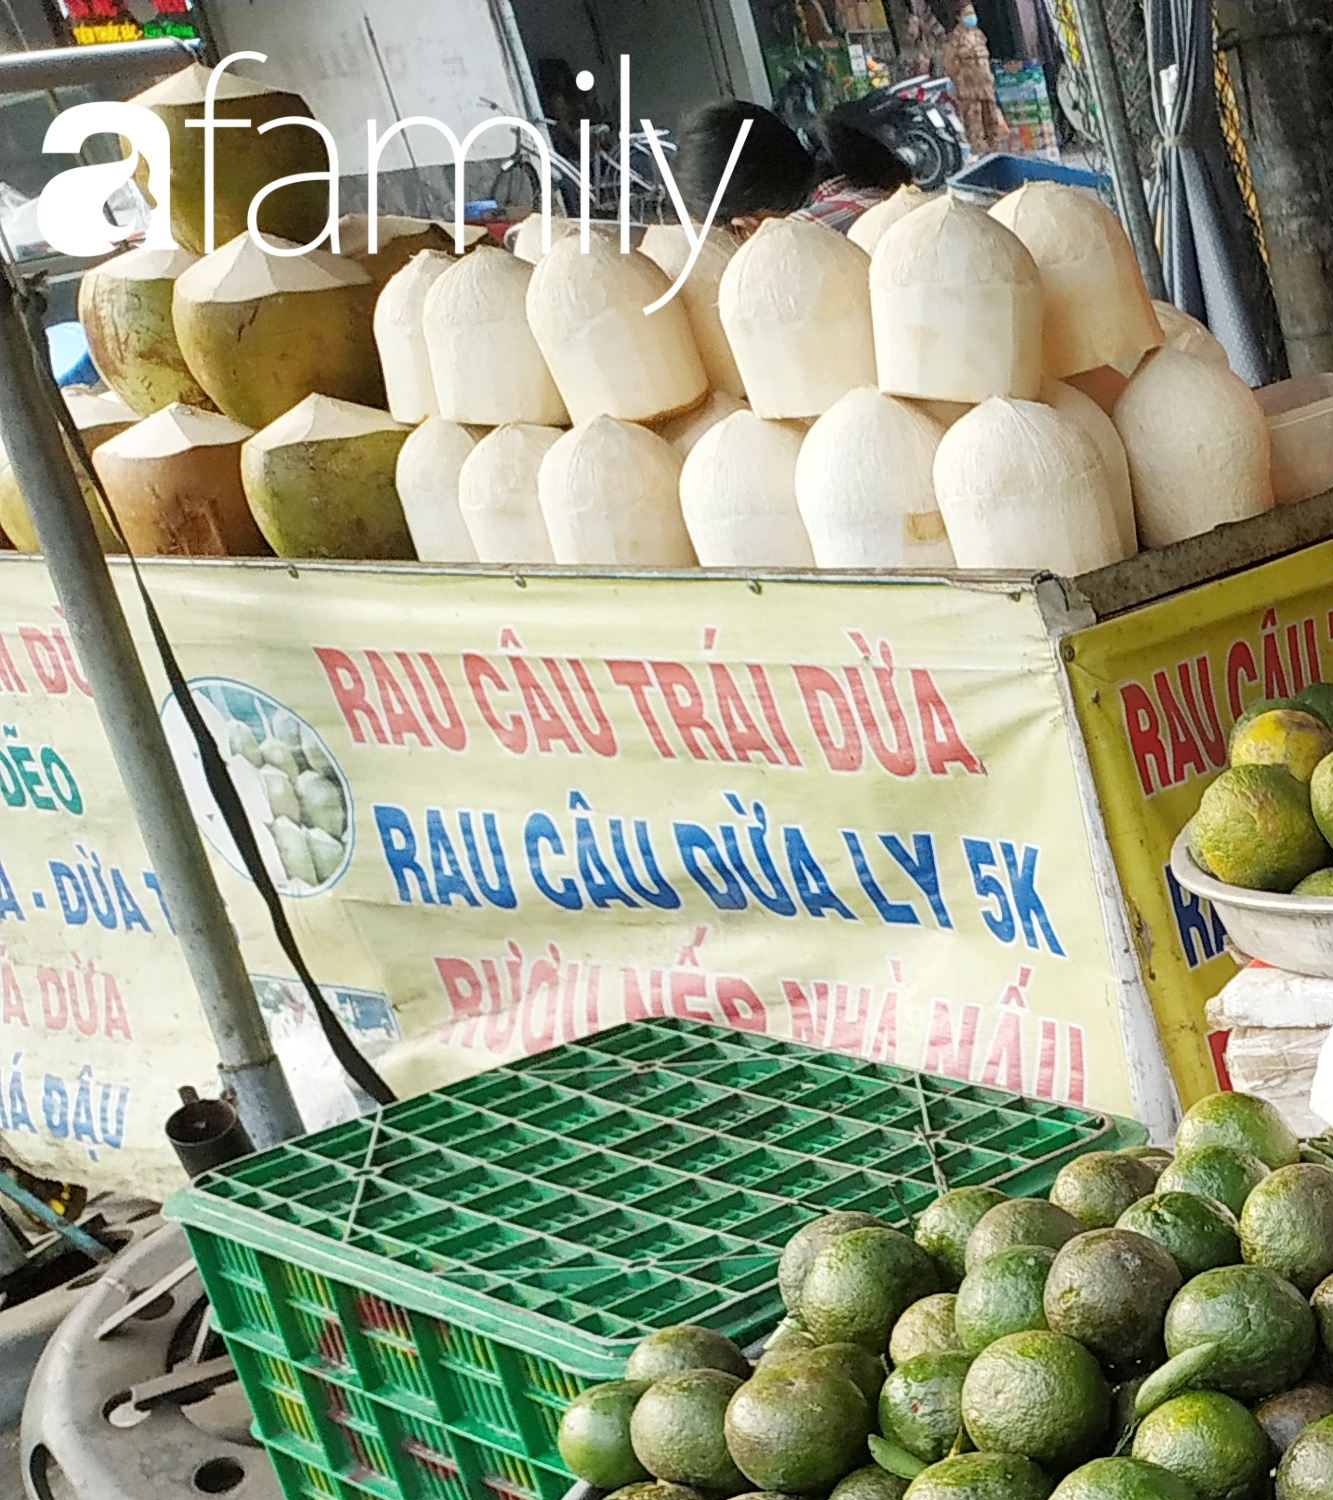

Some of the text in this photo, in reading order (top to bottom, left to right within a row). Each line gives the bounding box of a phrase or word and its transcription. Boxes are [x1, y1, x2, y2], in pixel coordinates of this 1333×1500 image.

[312, 627, 988, 778] RAU CÂU TRÁI DỪA
[1119, 655, 1229, 797] RAU
[48, 843, 153, 934] DỪA
[373, 803, 519, 910] RAU
[524, 790, 682, 911] CÂU
[675, 791, 858, 921] DỪA
[846, 831, 953, 930] LY
[962, 837, 1066, 959] 5K
[36, 951, 133, 1041] DỪA
[42, 1064, 130, 1162] ĐẬU
